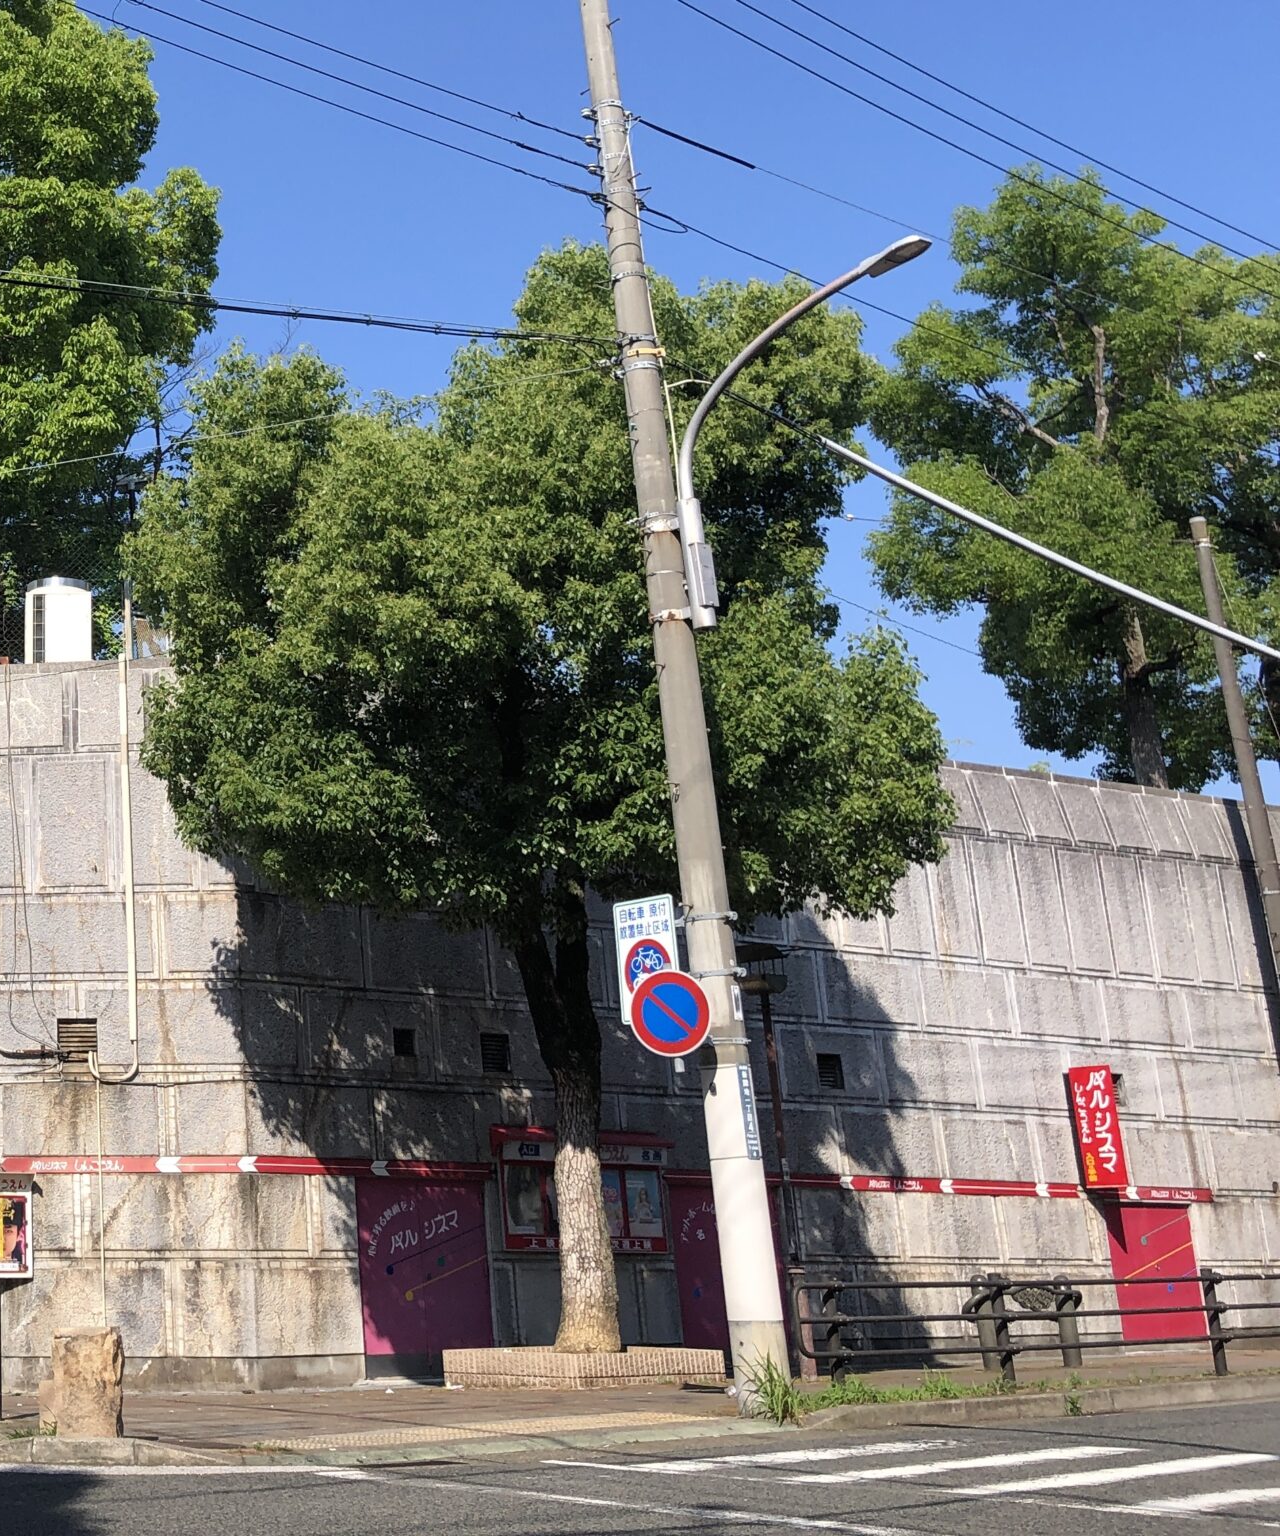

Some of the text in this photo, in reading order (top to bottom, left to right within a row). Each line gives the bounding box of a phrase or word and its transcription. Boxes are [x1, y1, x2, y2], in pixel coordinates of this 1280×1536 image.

[619, 906, 644, 922] 自転車
[619, 918, 669, 938] 放置禁止区域
[1085, 1069, 1117, 1173] パルシネマ
